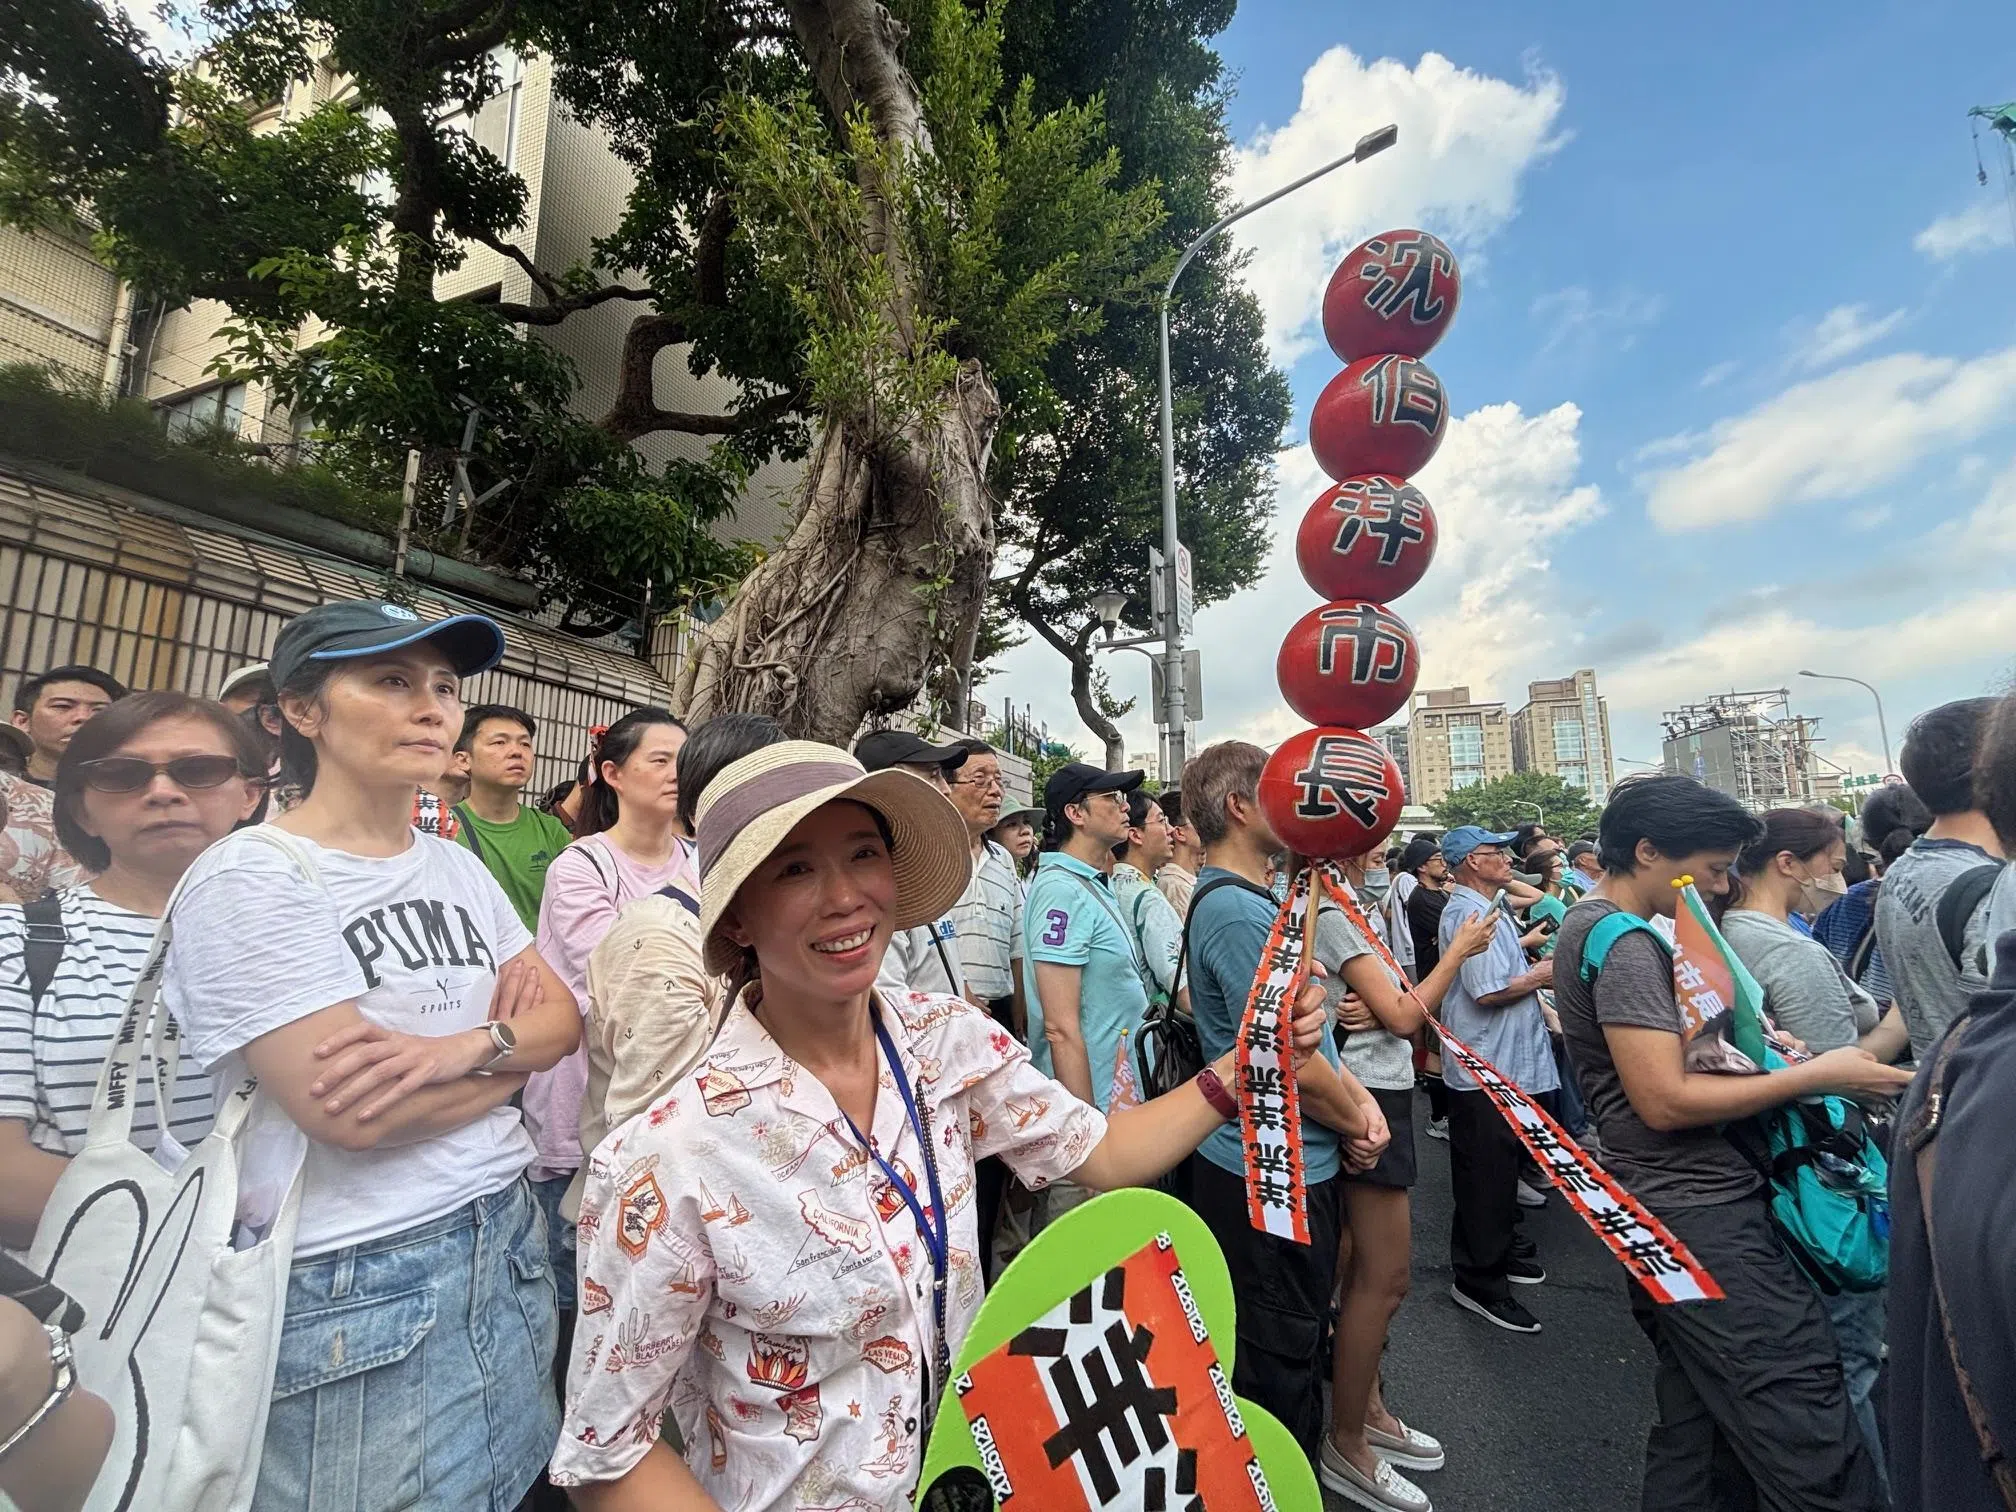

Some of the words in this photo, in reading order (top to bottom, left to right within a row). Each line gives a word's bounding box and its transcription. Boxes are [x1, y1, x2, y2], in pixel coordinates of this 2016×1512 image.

[341, 898, 497, 990] PUMA
[1042, 908, 1069, 947] 3
[118, 998, 144, 1046] MIFFY
[420, 999, 463, 1015] SPORTS
[1245, 983, 1289, 1055] 洋流
[107, 1061, 129, 1111] MIFFY
[1242, 1064, 1292, 1133] 洋流
[1249, 1142, 1297, 1213] 洋流
[813, 1208, 859, 1239] CALIFORNIA
[634, 1333, 675, 1354] BURBERRY
[635, 1348, 661, 1361] BLACK
[756, 1332, 803, 1355] Flamingo
[867, 1348, 883, 1358] LAS
[884, 1349, 906, 1363] VEGAS
[970, 1416, 1014, 1503] 20261128
